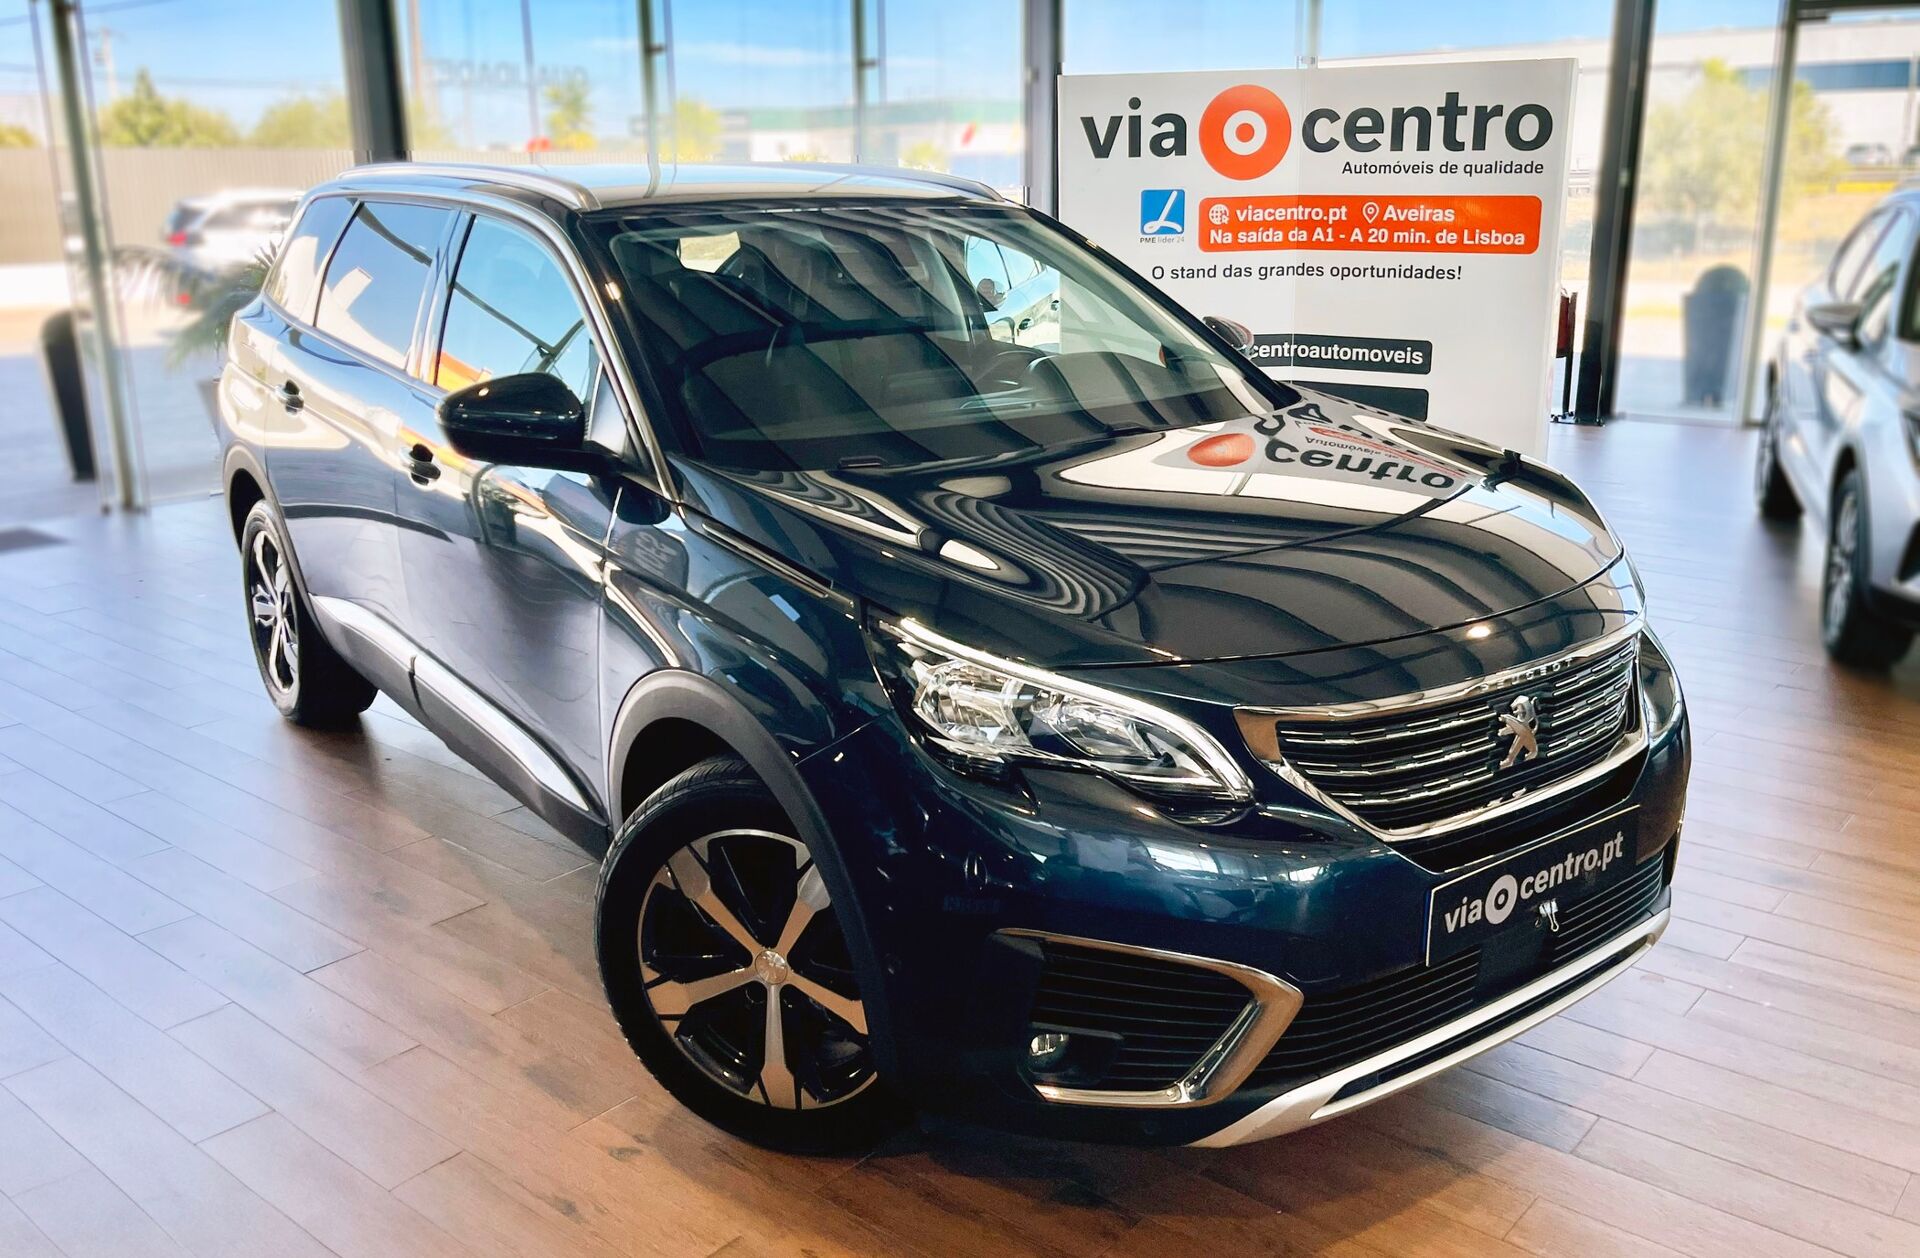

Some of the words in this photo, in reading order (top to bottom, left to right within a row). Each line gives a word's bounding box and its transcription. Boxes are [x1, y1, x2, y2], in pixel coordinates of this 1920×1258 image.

[1080, 96, 1187, 158] via
[1302, 92, 1554, 153] centro
[1342, 160, 1434, 174] Automóveis
[1439, 160, 1458, 174] de
[1463, 160, 1544, 177] qualidade
[1235, 204, 1348, 225] viacentro.pt
[1382, 204, 1456, 222] Aveiras
[1209, 228, 1233, 245] Na
[1237, 227, 1284, 243] saída
[1288, 227, 1308, 242] da
[1311, 227, 1335, 242] A1
[1350, 227, 1363, 242] A
[1367, 228, 1389, 243] 20
[1393, 228, 1431, 244] min.
[1435, 228, 1458, 244] de
[1463, 229, 1525, 246] Lisboa
[1151, 265, 1165, 280] O
[1170, 264, 1217, 279] stand
[1222, 264, 1253, 278] das
[1258, 262, 1325, 281] grandes
[1330, 263, 1462, 280] oportunidades!
[1444, 896, 1482, 934] via
[1520, 830, 1624, 900] centro.pt
